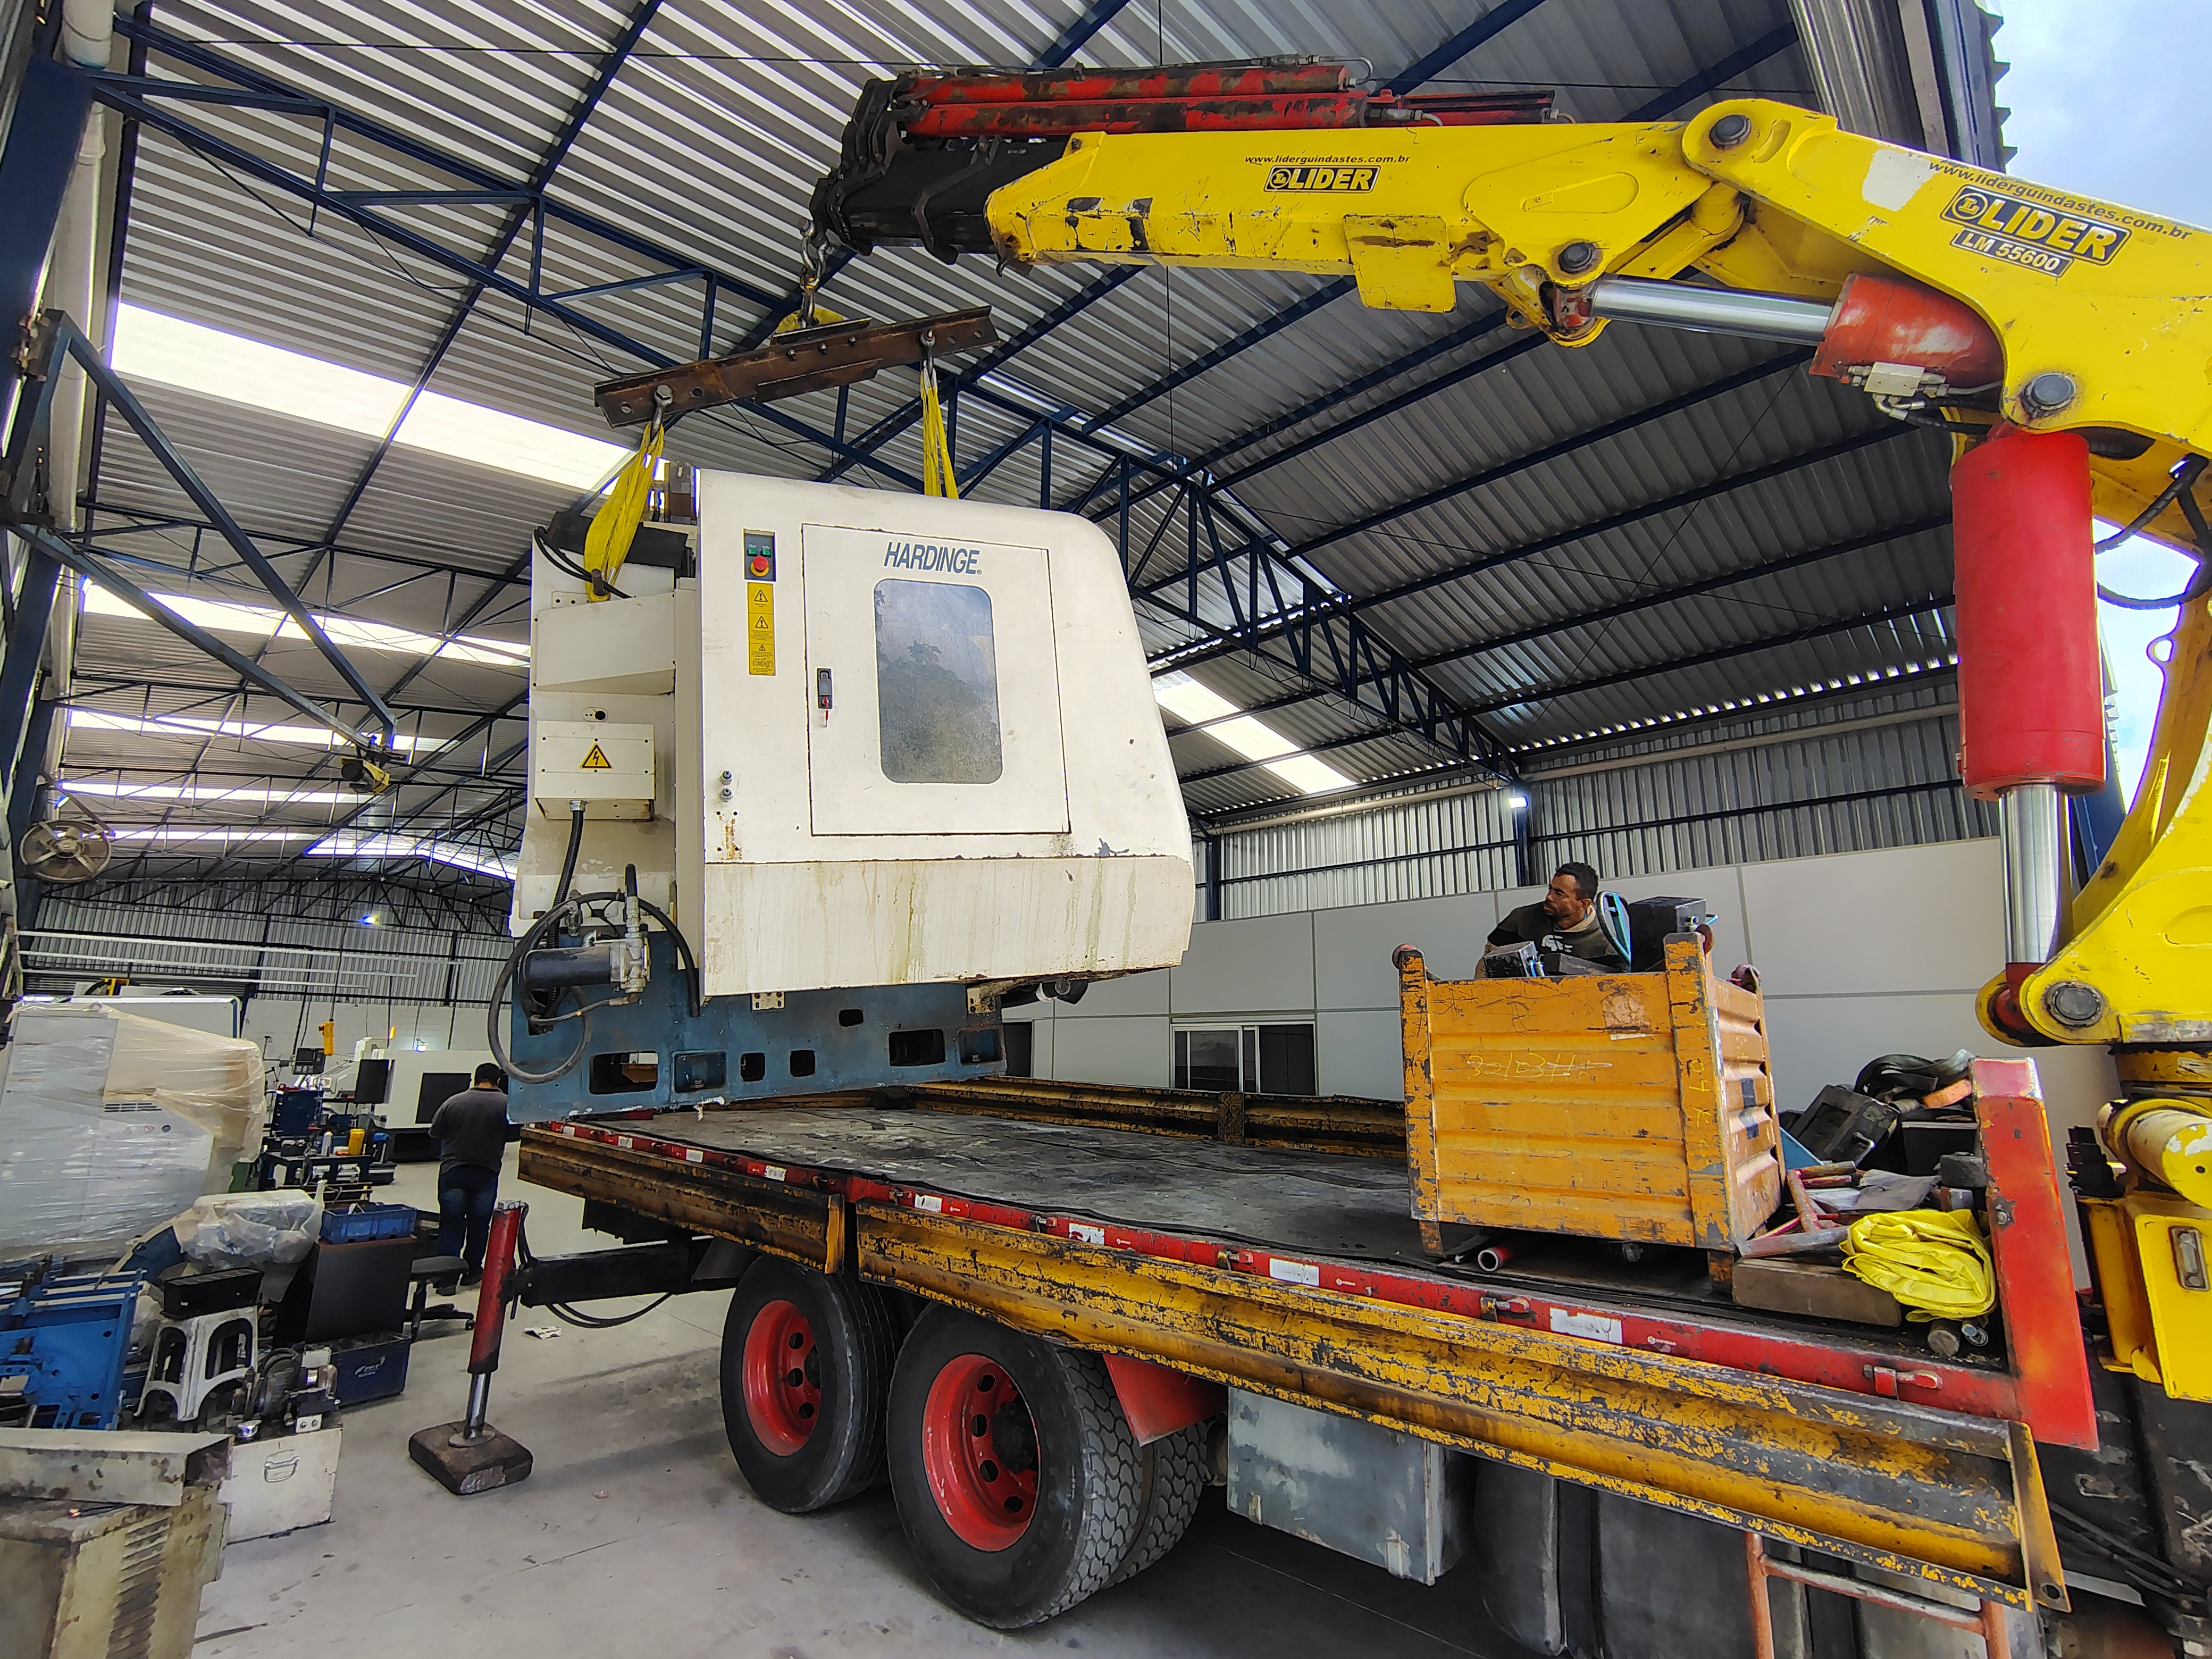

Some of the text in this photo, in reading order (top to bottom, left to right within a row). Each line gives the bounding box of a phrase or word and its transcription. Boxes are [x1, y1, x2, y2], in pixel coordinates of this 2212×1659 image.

[1245, 155, 1411, 164] www.liderguindastes.com.br
[1287, 169, 1373, 190] LIDER
[1929, 162, 2193, 240] www.liderguindastes.com.br
[1978, 198, 2118, 260] LIDER
[1961, 233, 2060, 271] LM 55600
[884, 541, 980, 574] HARDINGE
